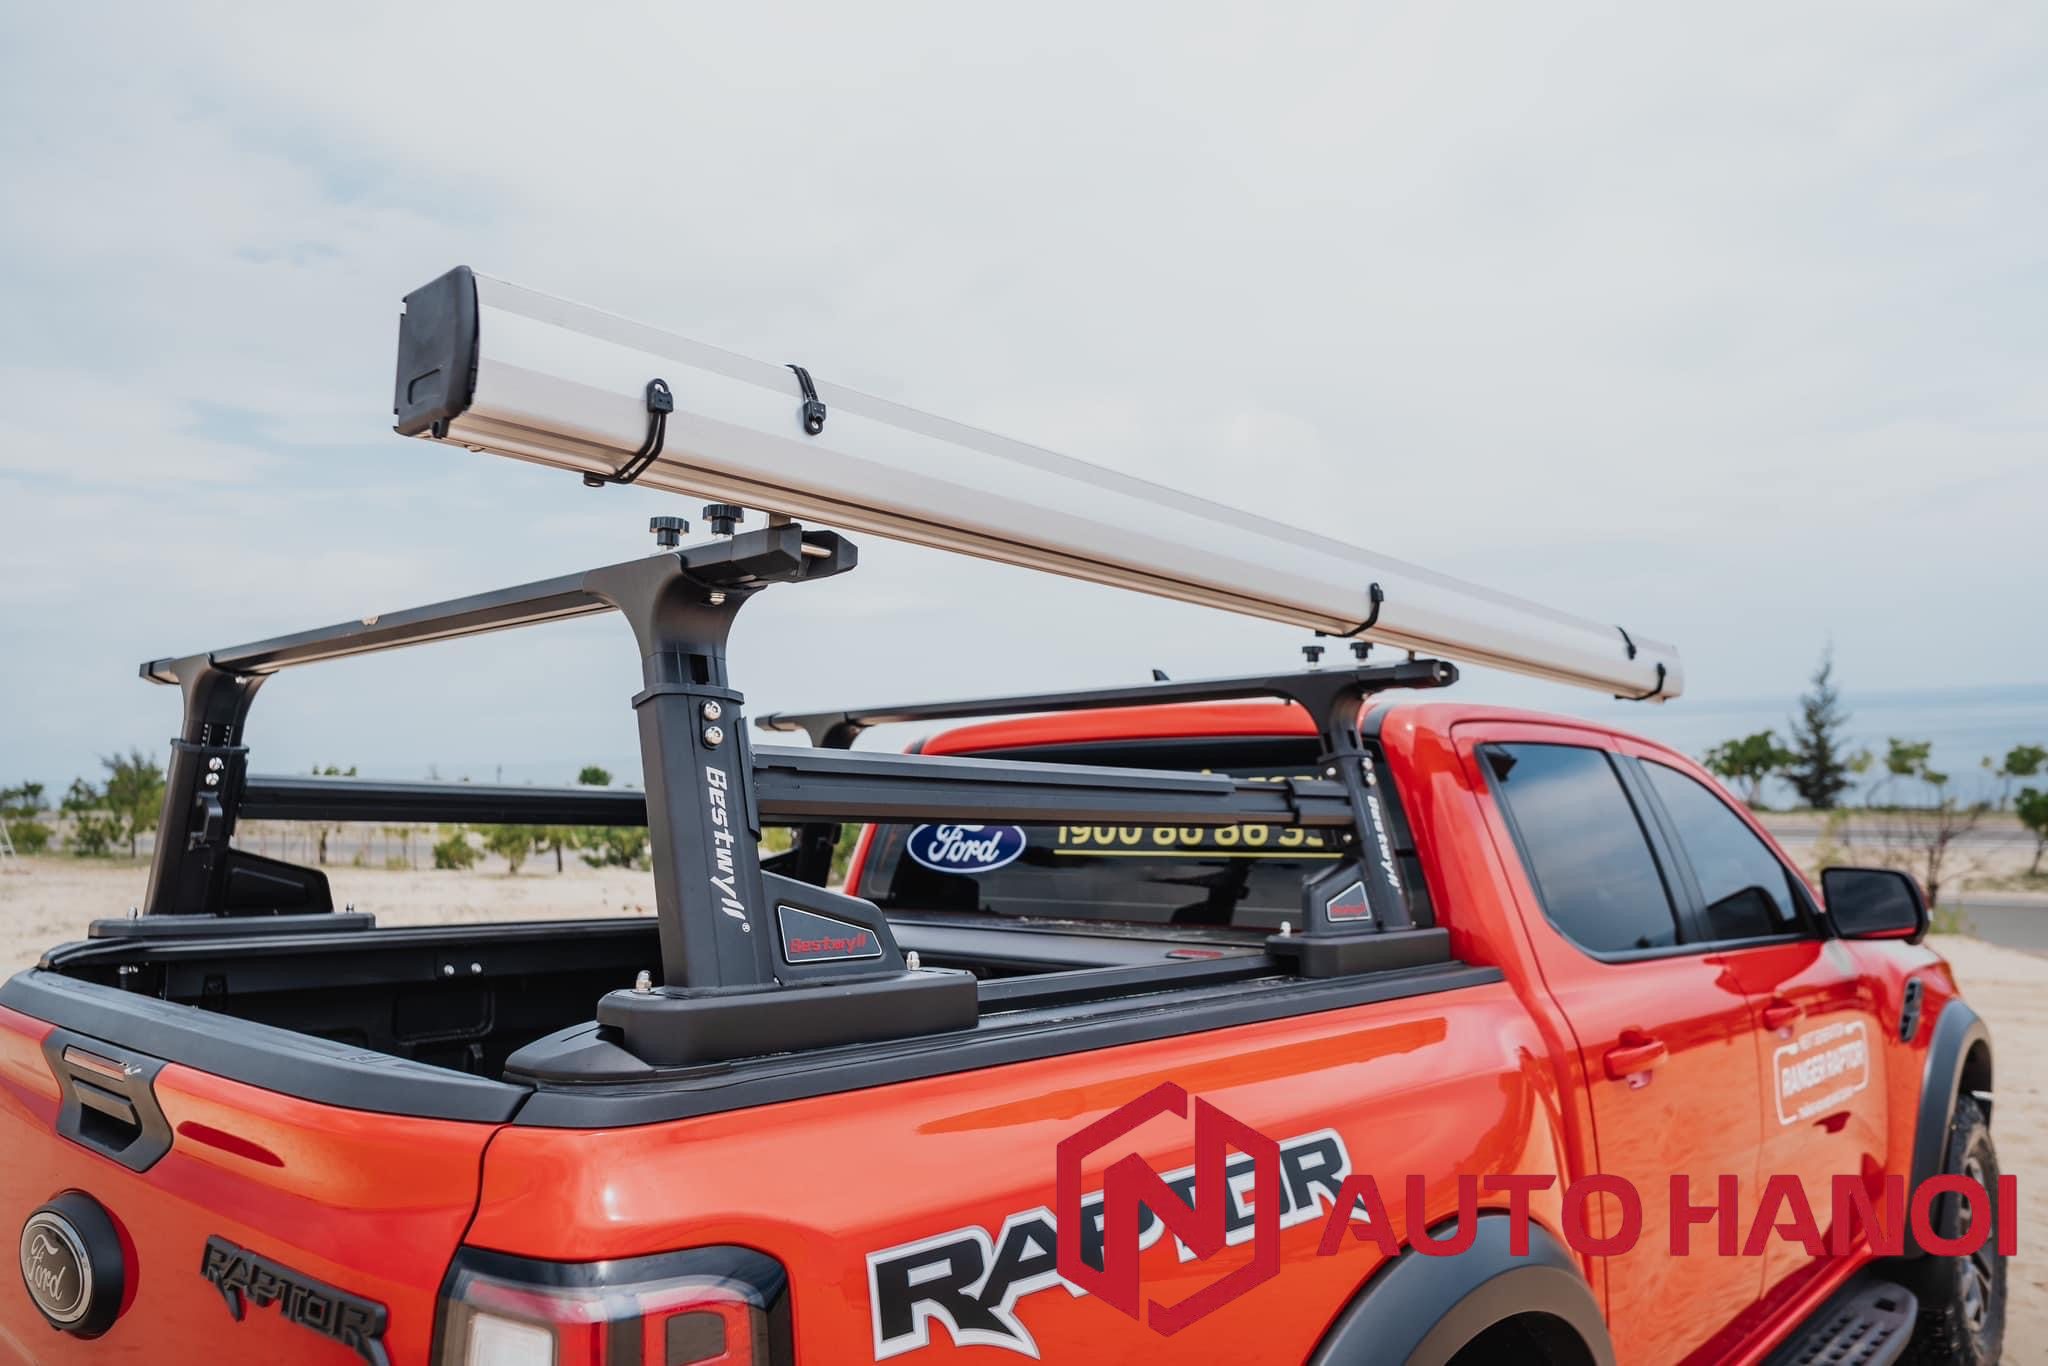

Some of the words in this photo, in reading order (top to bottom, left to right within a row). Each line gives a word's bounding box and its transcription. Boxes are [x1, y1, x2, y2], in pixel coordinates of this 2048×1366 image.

[928, 824, 1003, 862] Ford
[25, 1233, 67, 1302] Ford
[200, 1234, 391, 1366] RAPTOR
